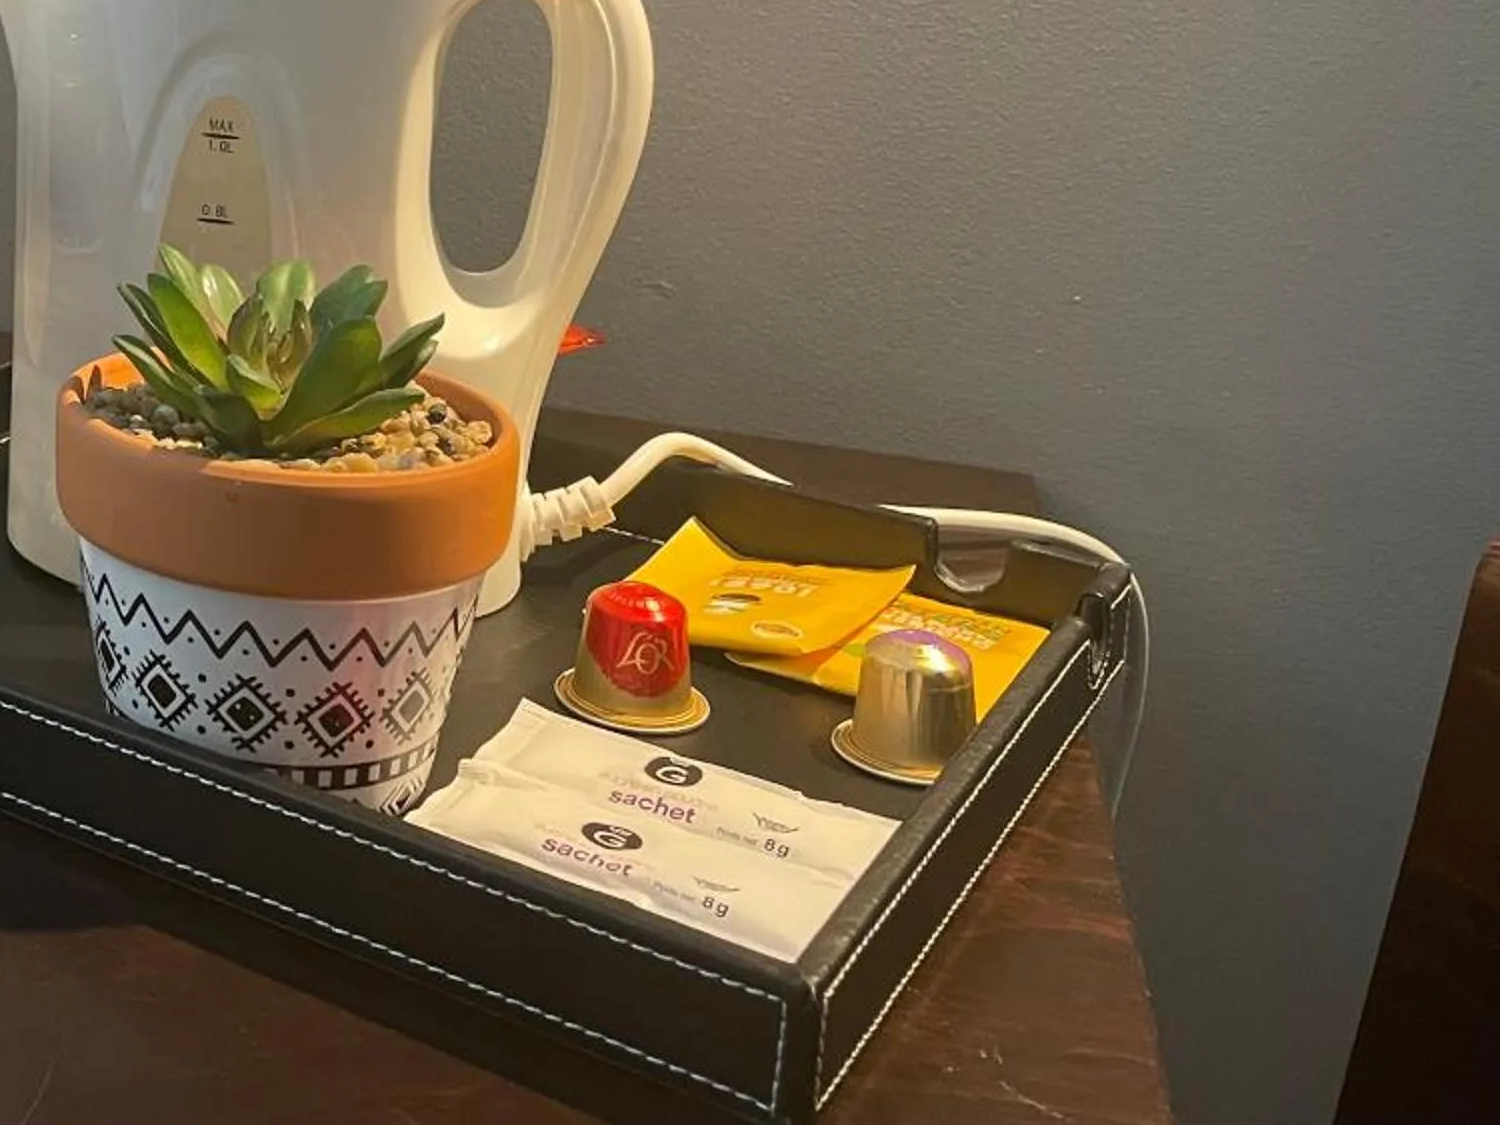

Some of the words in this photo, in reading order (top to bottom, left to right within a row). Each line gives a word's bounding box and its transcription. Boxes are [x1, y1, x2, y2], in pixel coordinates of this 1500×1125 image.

[209, 118, 235, 133] MAX
[608, 789, 697, 824] sachet
[540, 837, 634, 877] sachet
